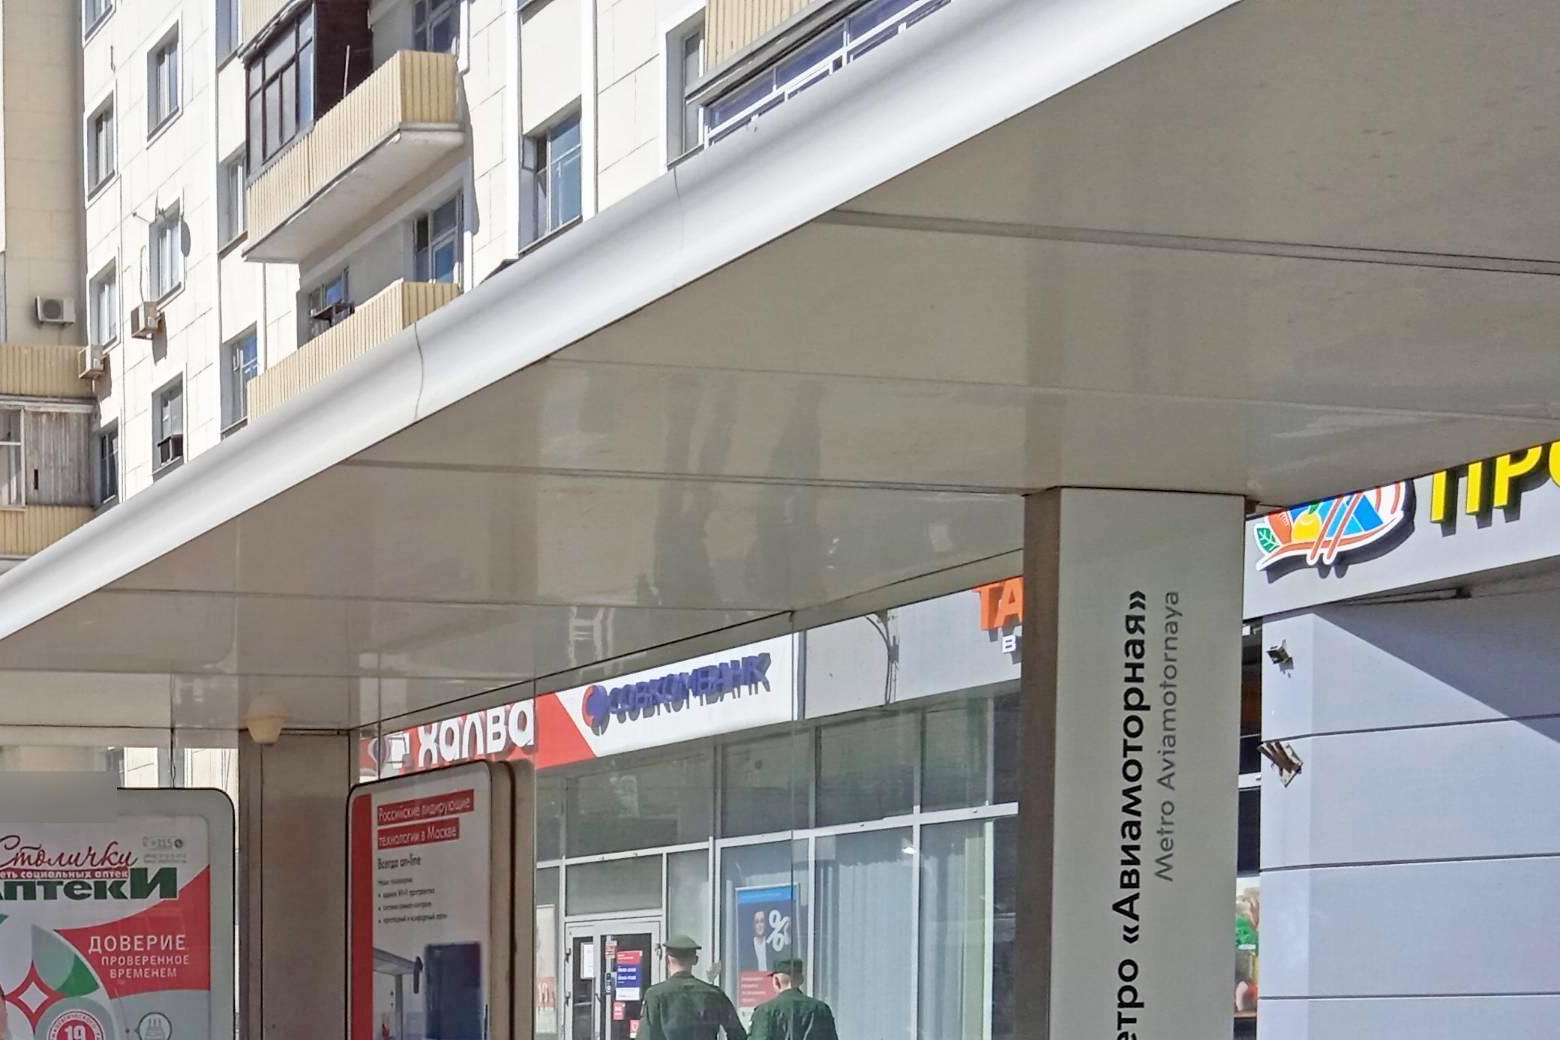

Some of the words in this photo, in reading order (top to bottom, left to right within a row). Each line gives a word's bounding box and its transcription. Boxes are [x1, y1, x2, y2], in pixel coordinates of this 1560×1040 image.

[1431, 437, 1560, 525] ПР
[1157, 591, 1183, 791] Aviamotornaya
[1112, 590, 1151, 944] «Авиамоторная»
[427, 825, 457, 841] Москве
[1154, 800, 1176, 882] Metro
[20, 870, 91, 879] социальных
[94, 870, 129, 879] аптек
[88, 934, 186, 954] ДОВЕРИЕ
[101, 954, 190, 966] ПРОВЕРЕННОЕ
[109, 967, 177, 979] ВРЕМЕНЕМ
